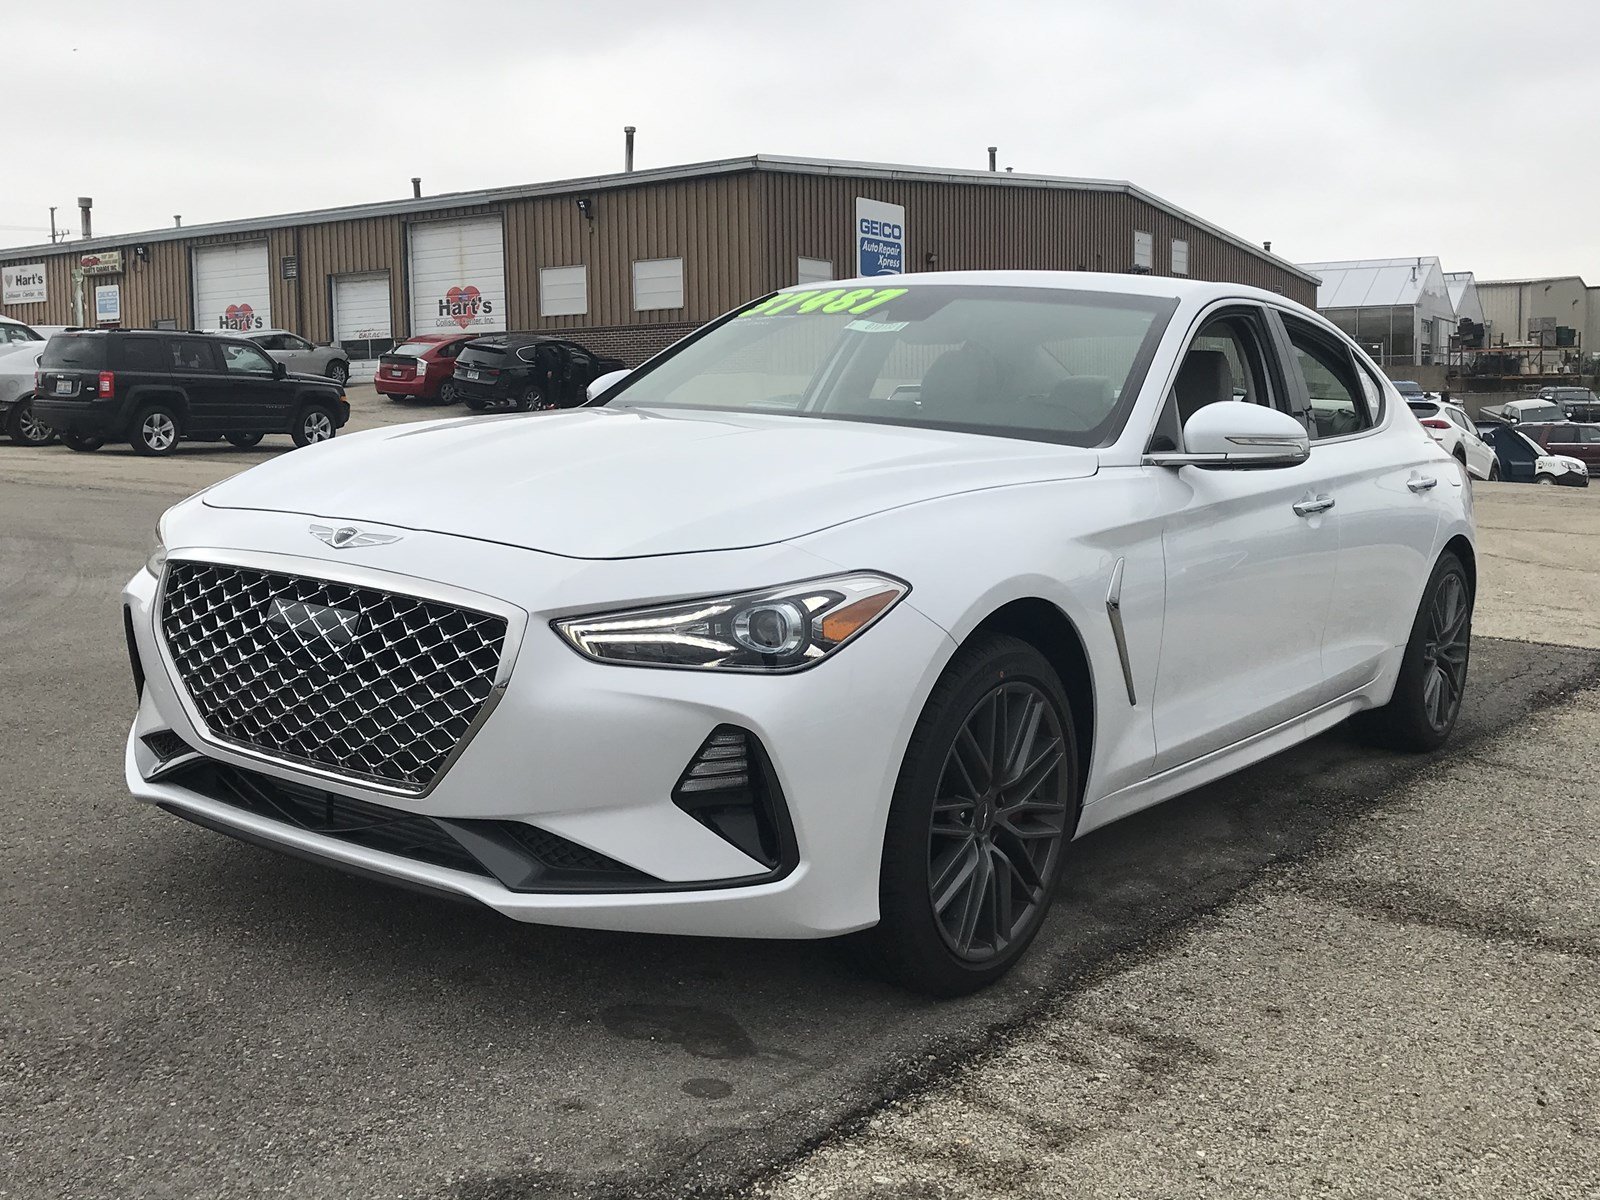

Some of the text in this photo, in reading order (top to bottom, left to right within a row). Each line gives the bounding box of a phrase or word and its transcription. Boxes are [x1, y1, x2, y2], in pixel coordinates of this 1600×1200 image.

[860, 218, 902, 240] GEICO
[862, 240, 900, 257] Auto Repair
[878, 255, 900, 268] Xpress
[15, 273, 43, 286] Hart's
[438, 296, 493, 316] Hart's
[219, 313, 263, 330] Hart's
